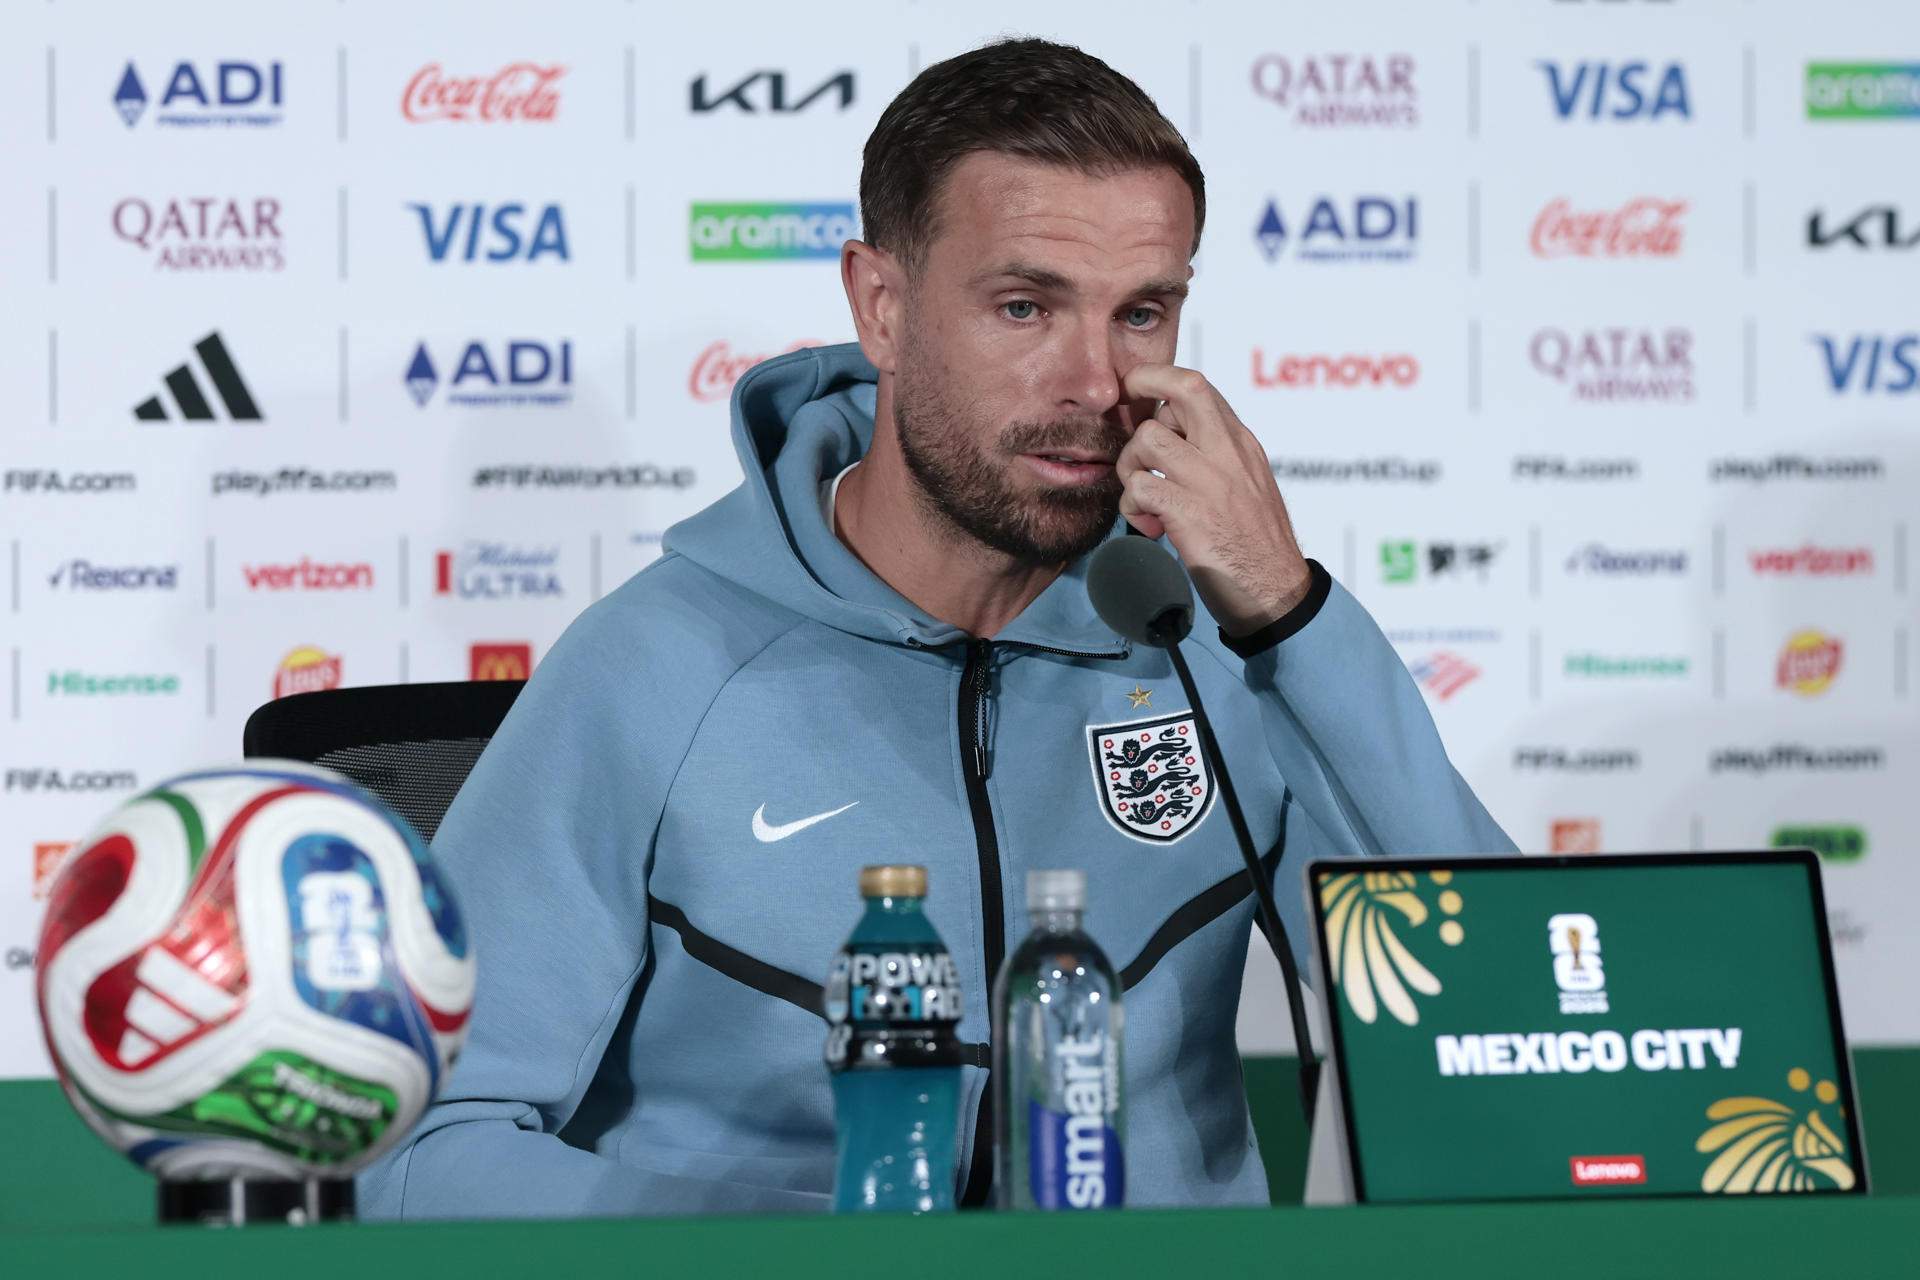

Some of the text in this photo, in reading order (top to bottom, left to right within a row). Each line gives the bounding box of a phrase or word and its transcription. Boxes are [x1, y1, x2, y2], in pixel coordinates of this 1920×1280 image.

[160, 61, 283, 107] ADI
[400, 62, 566, 123] Coca-Cola
[689, 70, 856, 114] KIA
[1250, 54, 1416, 105] QATAR
[1539, 61, 1693, 122] VISA
[111, 198, 282, 249] QATAR
[410, 202, 571, 263] VISA
[696, 215, 852, 249] aramco
[1301, 196, 1417, 241] ADI
[1529, 197, 1688, 258] Coca-Cola
[158, 247, 285, 271] AIRWAYS
[450, 341, 573, 386] ADI
[1251, 348, 1420, 389] Lenovo
[1529, 328, 1694, 382] QATAR
[4, 470, 136, 494] FIFA.com
[211, 467, 396, 497] play.fifa.com
[70, 560, 178, 591] Rexona
[243, 557, 374, 591] verizon
[1751, 545, 1874, 577] verizon
[458, 573, 563, 598] ULTRA
[47, 671, 181, 696] Hisense
[1564, 653, 1692, 678] Hisense
[5, 768, 137, 792] FIFA.com
[1435, 1028, 1742, 1076] MEXICO CITY
[1056, 1028, 1106, 1208] smart
[1575, 1160, 1641, 1181] Lenovo
